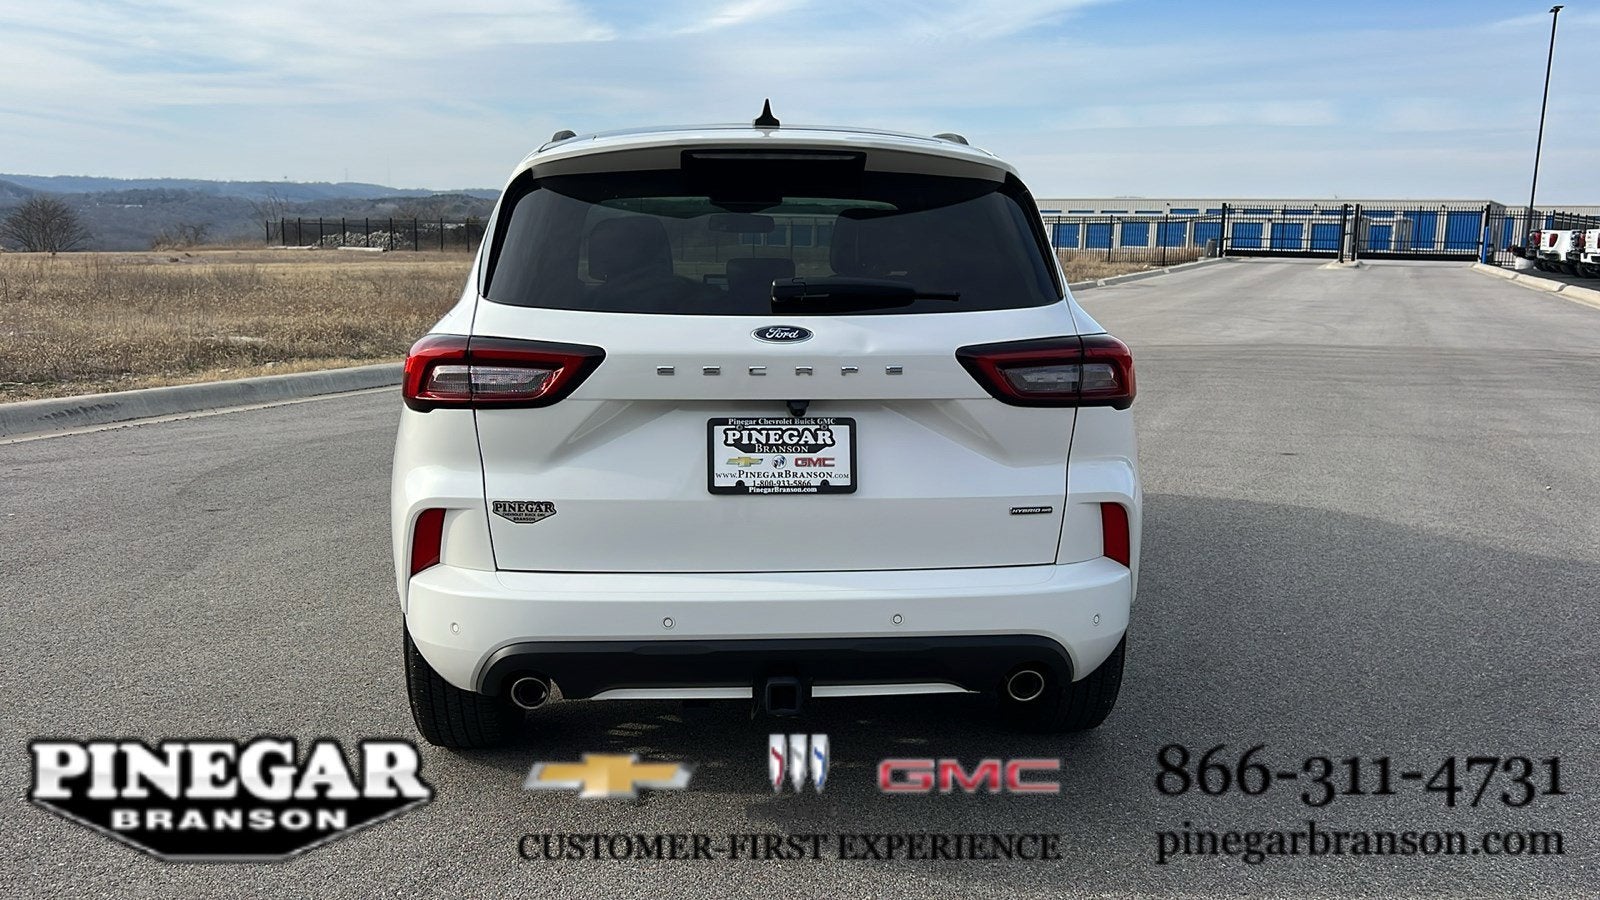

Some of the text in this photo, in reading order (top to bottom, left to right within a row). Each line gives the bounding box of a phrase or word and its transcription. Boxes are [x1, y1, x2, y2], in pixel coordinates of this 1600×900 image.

[765, 327, 799, 339] Ford
[656, 365, 903, 376] ESCAPE
[728, 418, 757, 426] Pinegar
[725, 430, 835, 445] PINEGAR
[755, 444, 809, 453] BRANSON
[794, 457, 835, 467] GMC
[749, 486, 818, 494] PinegarBranson.com
[495, 502, 554, 512] PINEGAR
